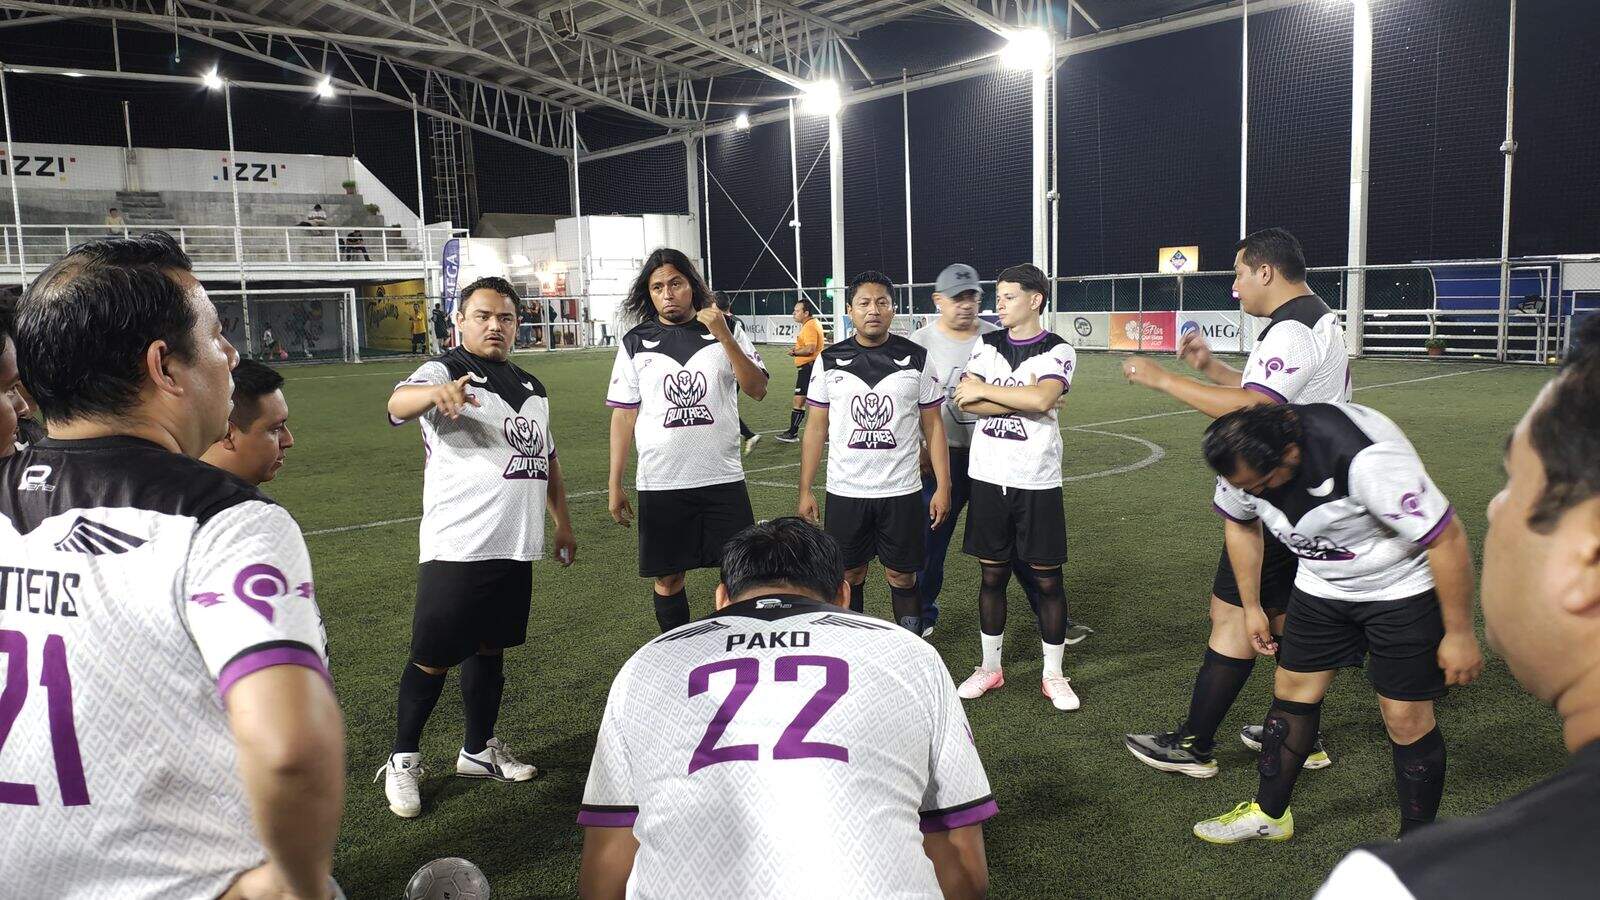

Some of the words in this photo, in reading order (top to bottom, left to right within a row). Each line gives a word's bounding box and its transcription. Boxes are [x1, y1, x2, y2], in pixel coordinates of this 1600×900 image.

[682, 418, 695, 426] VT
[526, 469, 539, 478] VT
[726, 631, 810, 652] PAKO
[688, 655, 849, 775] 22
